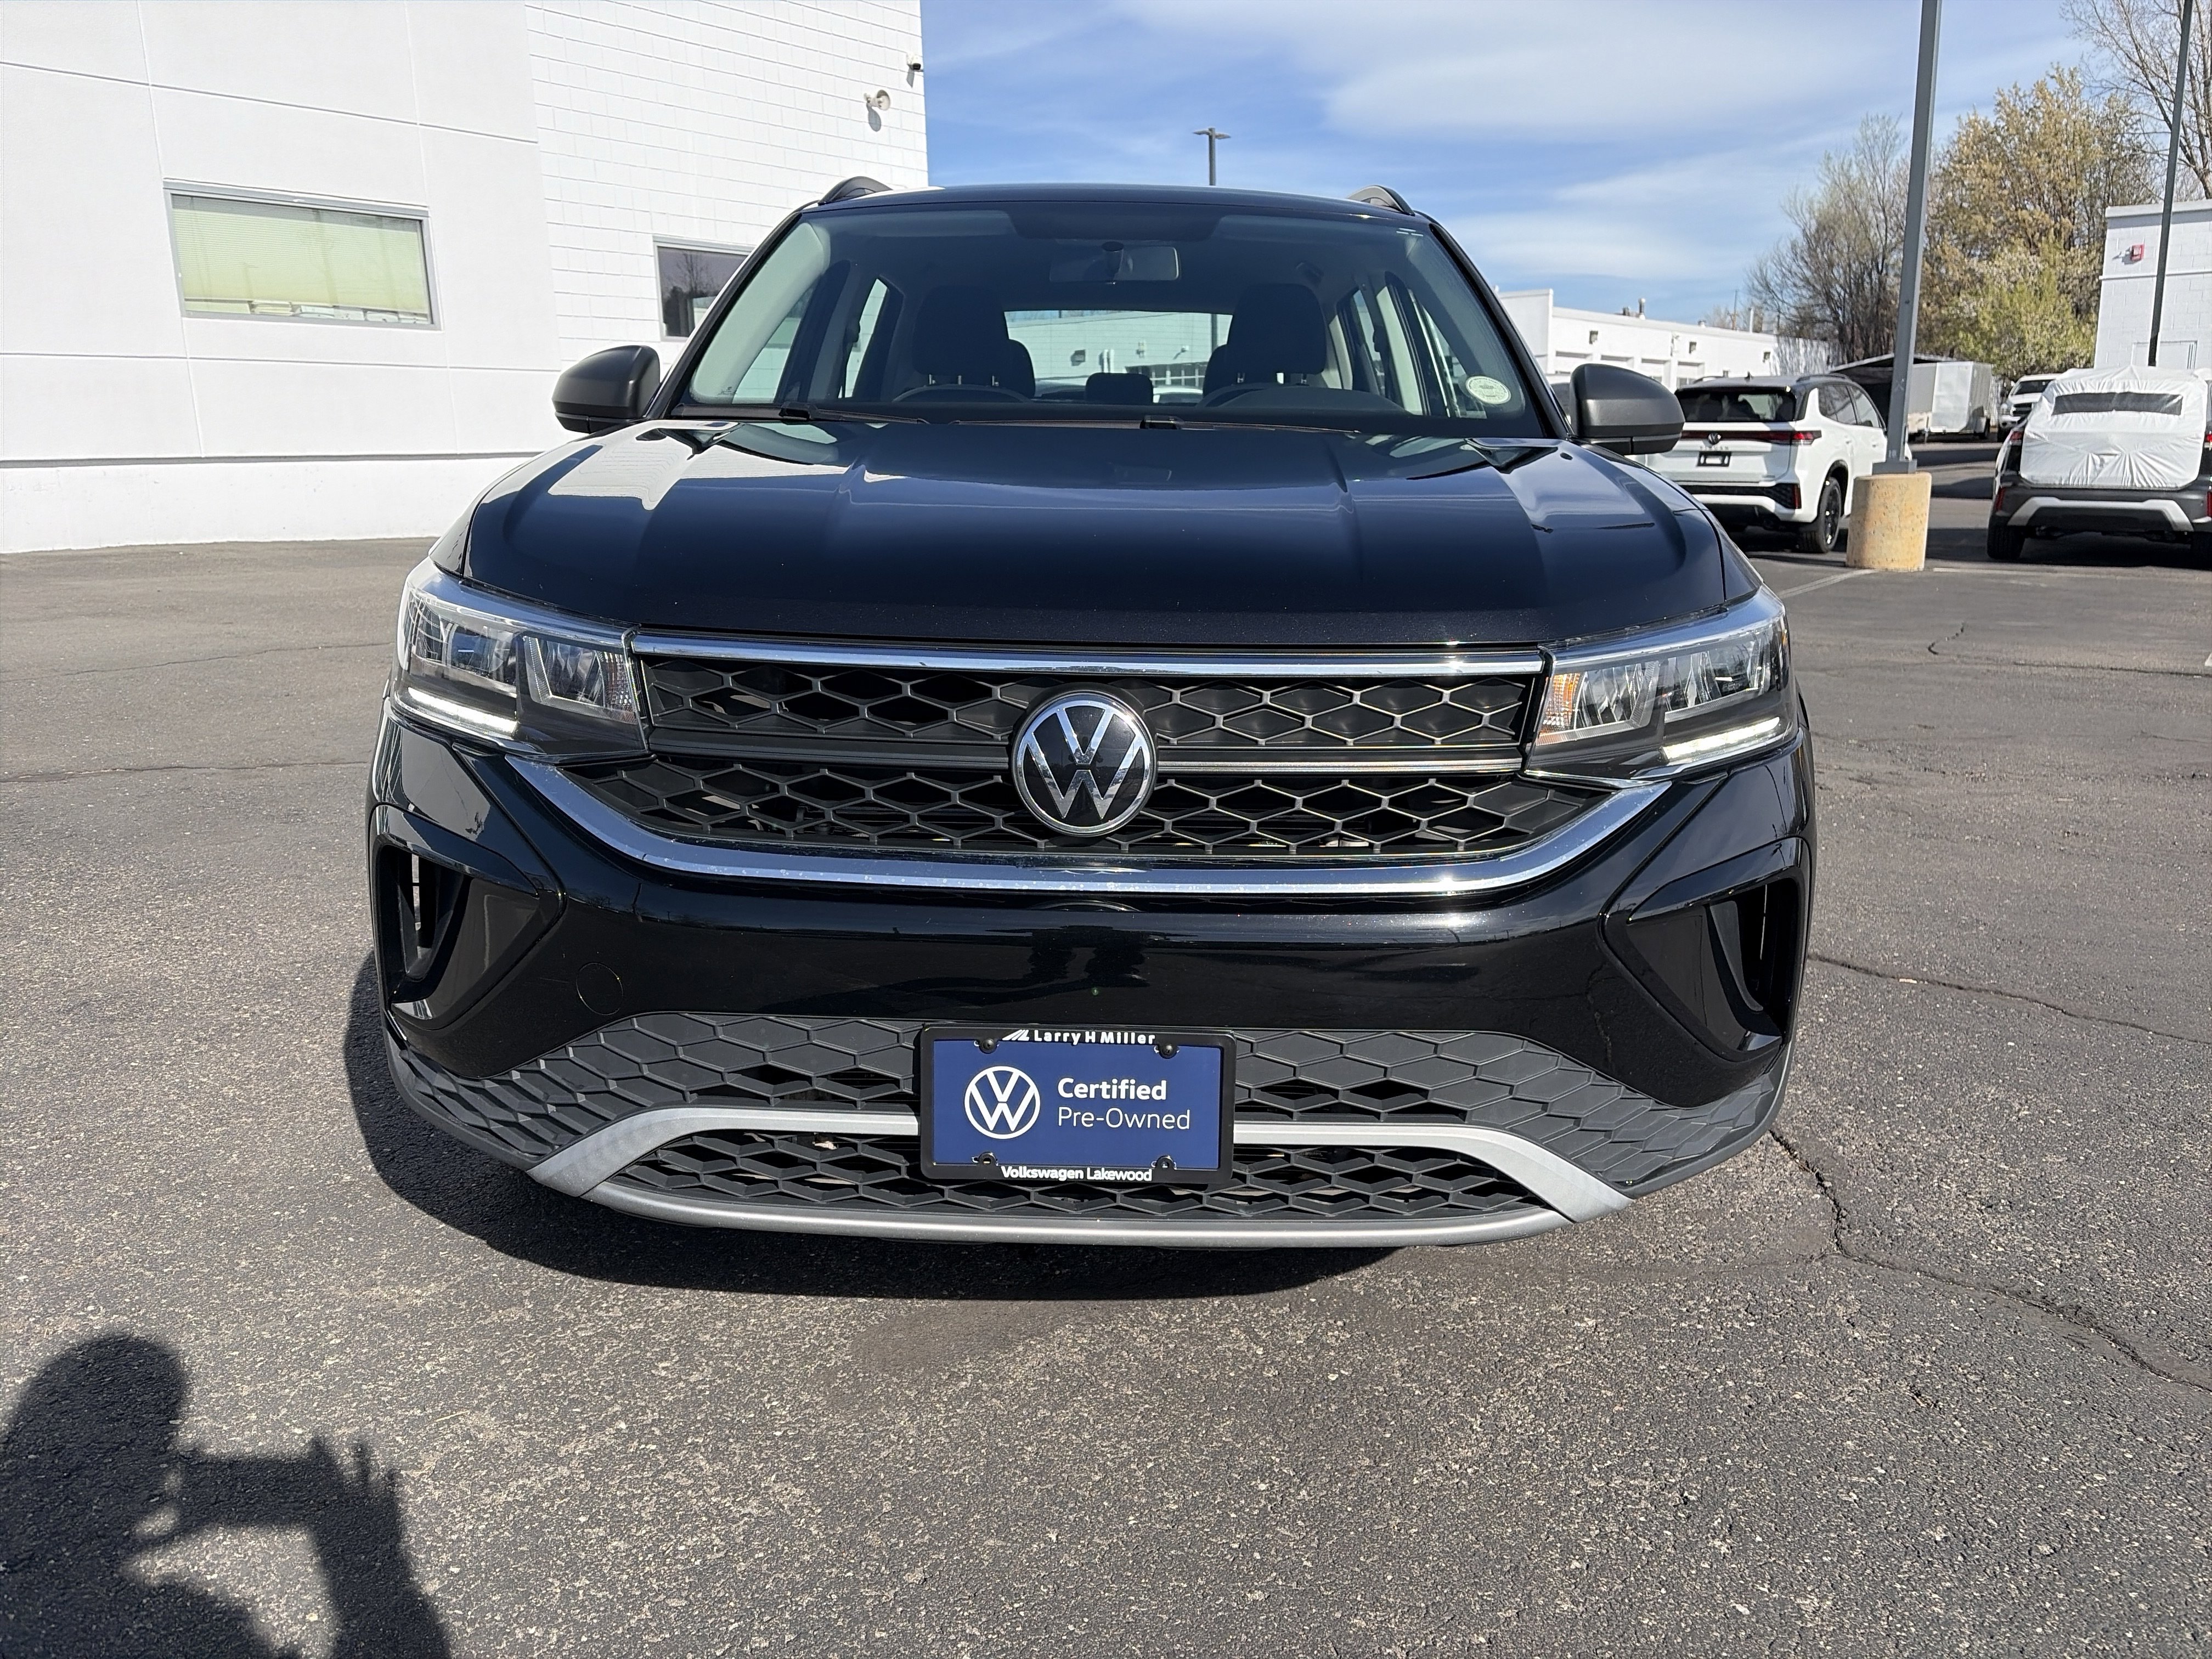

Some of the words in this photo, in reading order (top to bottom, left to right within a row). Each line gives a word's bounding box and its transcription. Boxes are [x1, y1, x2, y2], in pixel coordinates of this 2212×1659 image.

[1034, 1029, 1081, 1046] Larry
[1085, 1031, 1096, 1043] H
[1100, 1031, 1155, 1045] Miller
[1057, 1077, 1167, 1101] Certified
[965, 1066, 1040, 1138] VW
[1058, 1107, 1190, 1130] Pre-Owned
[1001, 1166, 1084, 1181] Volkswagen
[1086, 1167, 1153, 1182] Lakewood
